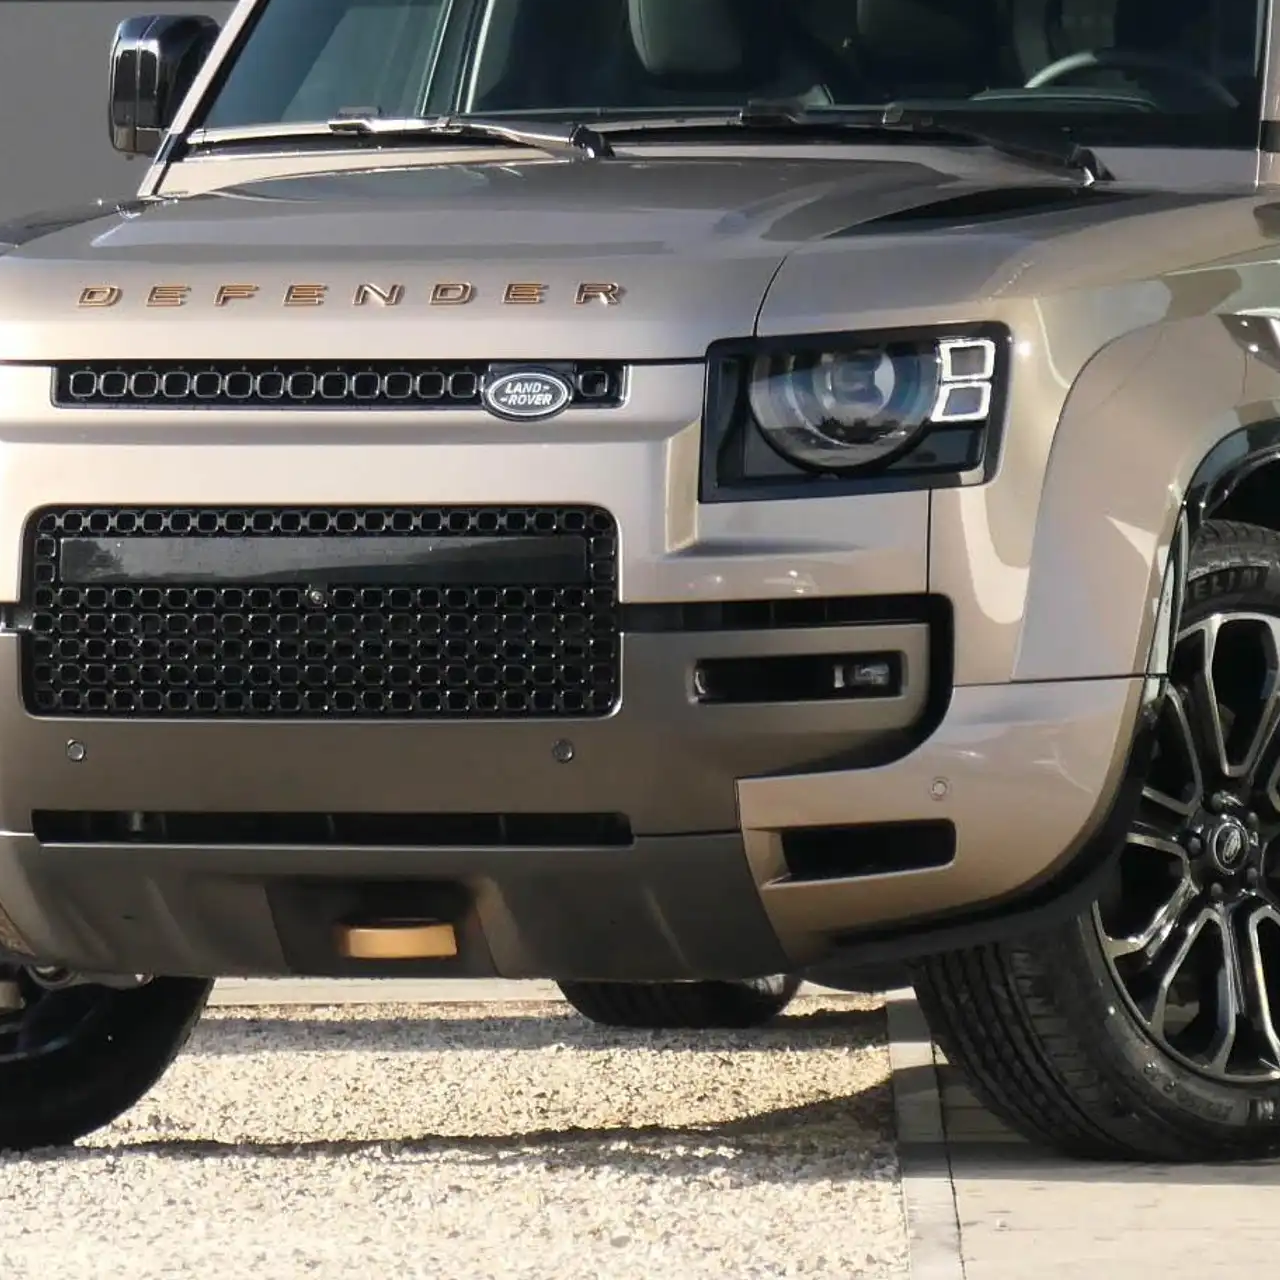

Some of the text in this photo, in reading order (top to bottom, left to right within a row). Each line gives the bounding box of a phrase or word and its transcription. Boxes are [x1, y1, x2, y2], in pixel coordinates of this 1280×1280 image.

[76, 282, 627, 308] DEFENDER
[505, 381, 542, 395] LAND
[507, 393, 553, 406] ROVER
